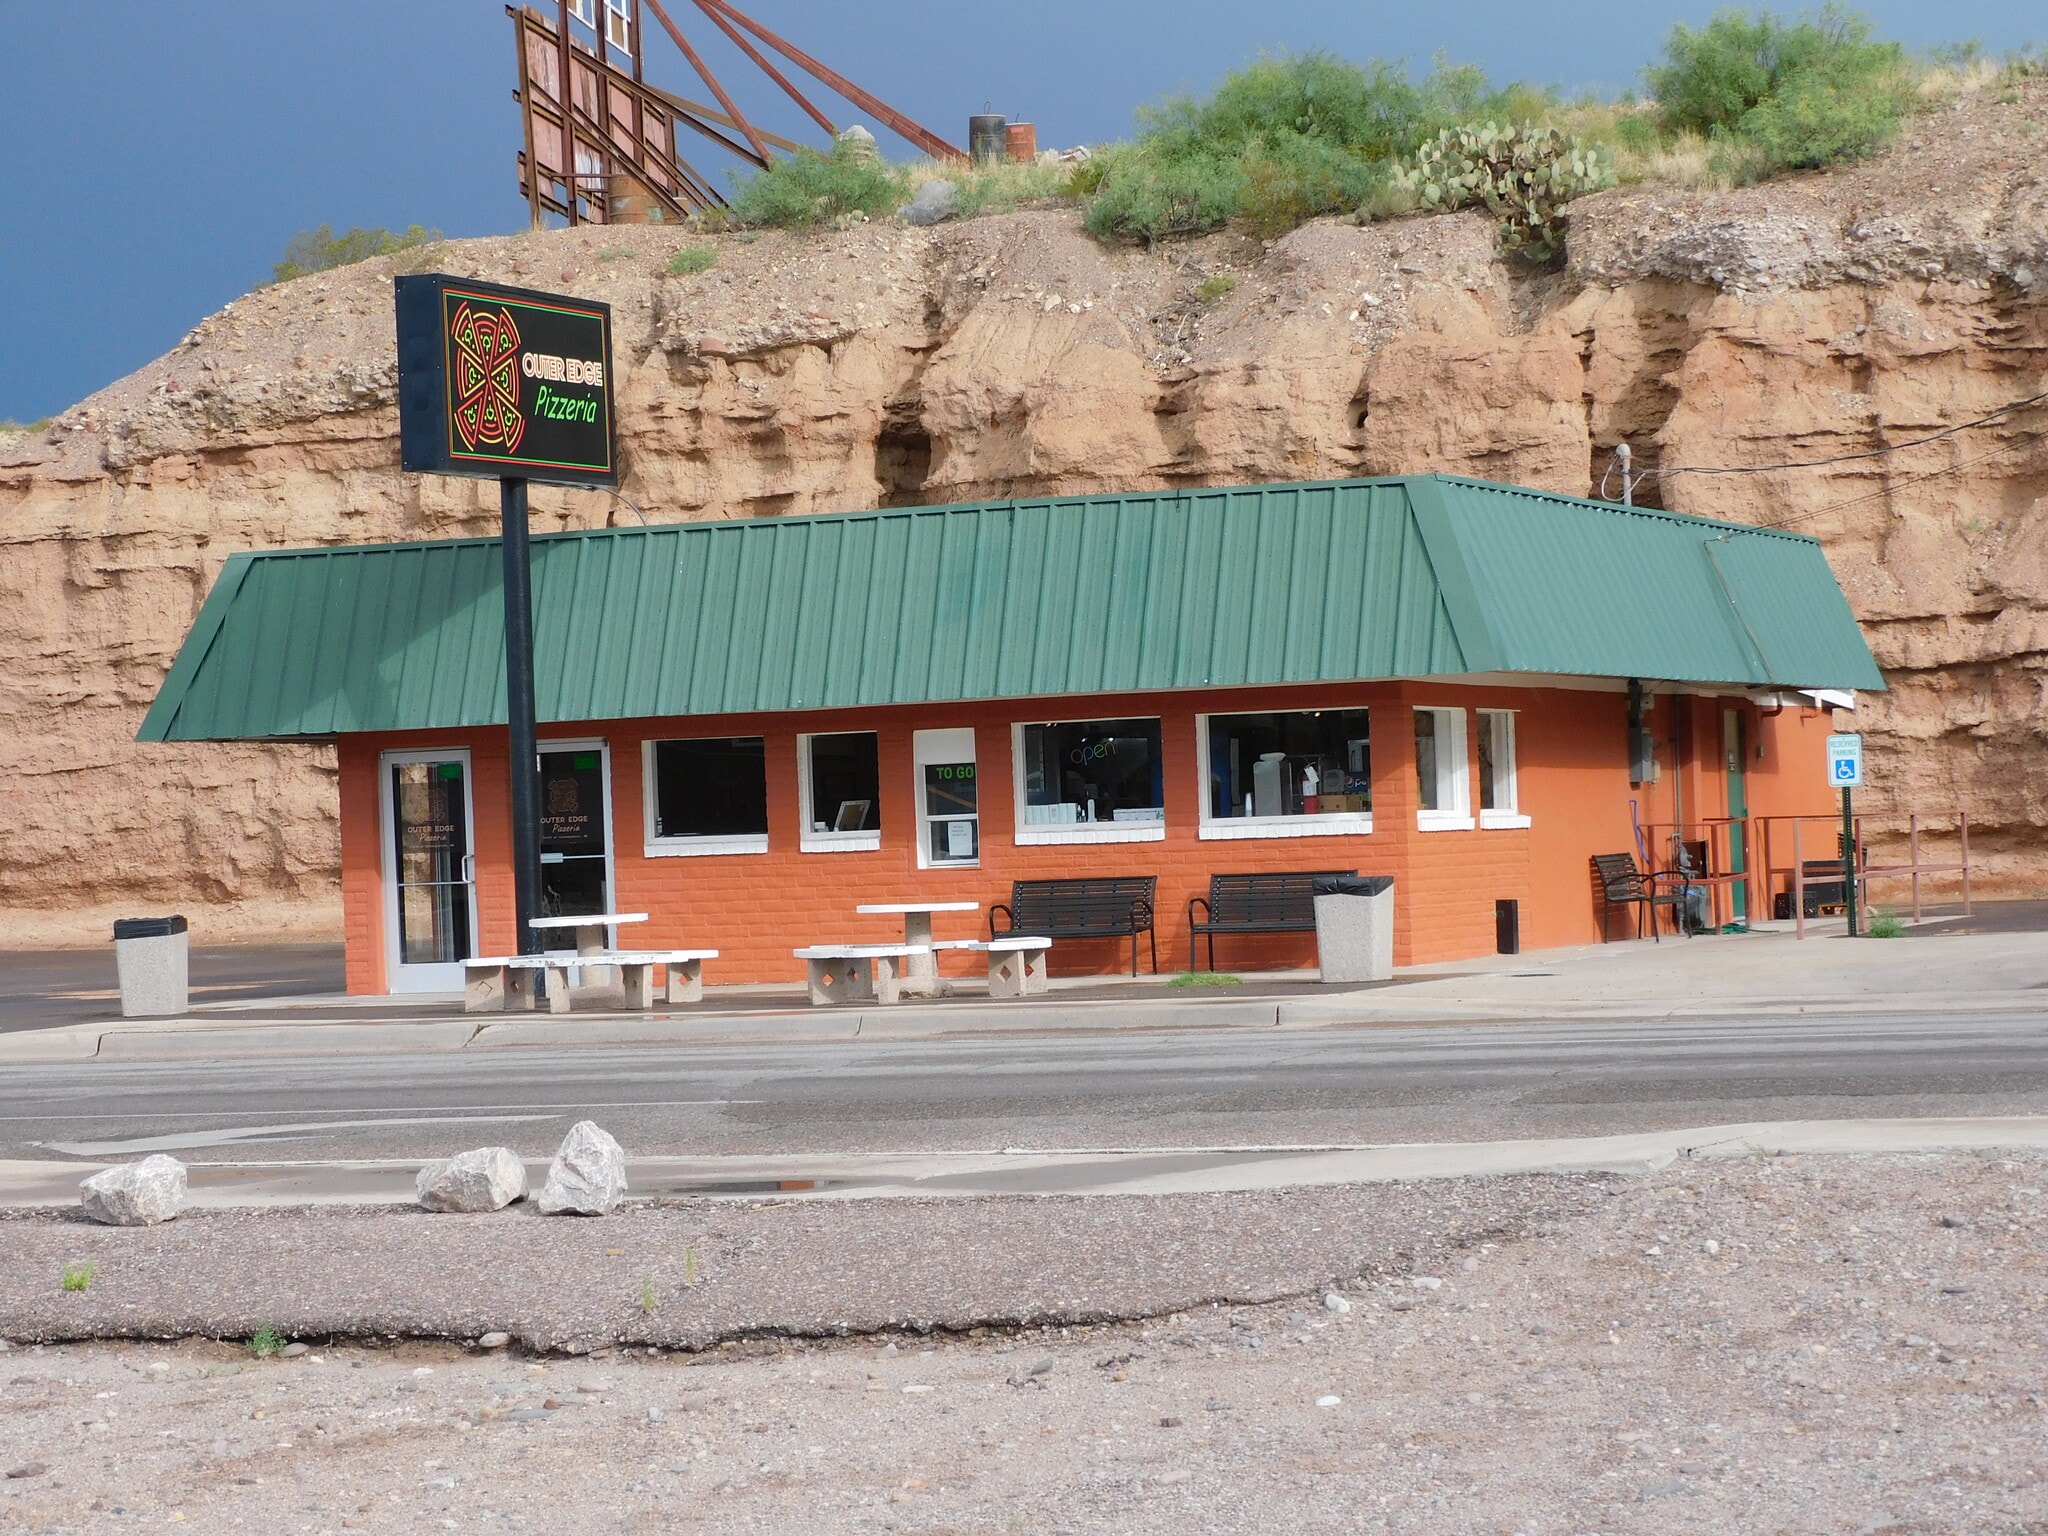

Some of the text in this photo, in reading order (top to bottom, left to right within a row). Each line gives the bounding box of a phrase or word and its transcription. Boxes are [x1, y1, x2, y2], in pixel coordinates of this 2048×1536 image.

[522, 352, 603, 387] OUTER EDGE
[534, 385, 598, 423] Pizzeria
[1830, 740, 1858, 748] RESERVED
[1071, 742, 1116, 766] open
[1832, 748, 1857, 756] PARKING
[936, 766, 974, 780] TO GO
[540, 815, 589, 824] OUTER EDGE
[407, 824, 455, 834] OUTER EDGE
[552, 823, 581, 834] Pizzeria
[419, 832, 448, 843] Pizzeria
